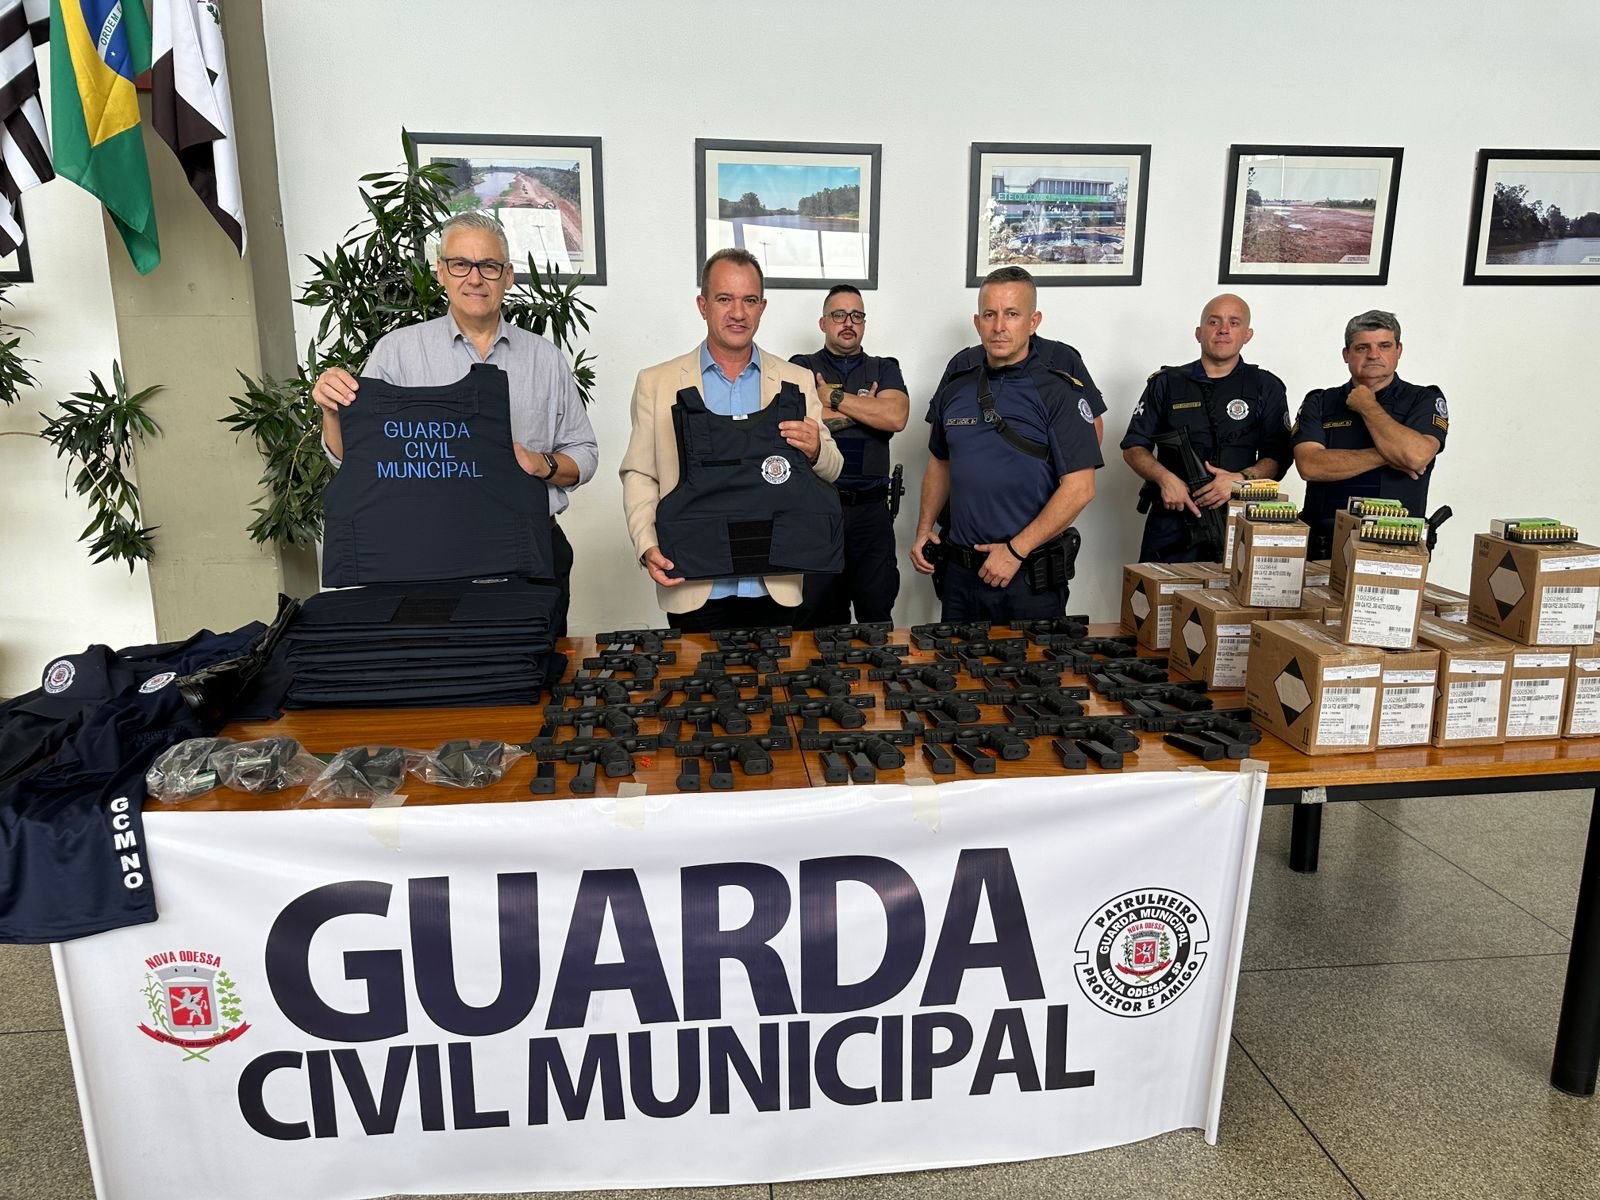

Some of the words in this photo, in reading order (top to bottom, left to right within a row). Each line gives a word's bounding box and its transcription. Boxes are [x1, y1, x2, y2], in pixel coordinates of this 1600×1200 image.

[100, 12, 119, 46] ORDEM
[383, 420, 470, 439] GUARDA
[404, 441, 456, 459] CIVIL
[377, 461, 483, 478] MUNICIPAL
[1095, 893, 1198, 929] PATRULHEIRO
[1127, 923, 1143, 934] NOVA
[1144, 921, 1165, 931] ODESSA
[265, 848, 1045, 1042] GUARDA
[1099, 913, 1138, 955] GUARDA
[1140, 908, 1189, 948] MUNICIPAL
[145, 950, 178, 970] NOVA
[179, 950, 222, 968] ODESSA
[1083, 966, 1142, 1012] PROTETOR
[1147, 998, 1156, 1010] E
[1160, 960, 1199, 1005] AMIGO
[1101, 968, 1126, 994] NOVA
[1127, 981, 1168, 998] ODESSA
[1172, 961, 1183, 977] SP
[238, 1042, 509, 1140] CIVIL
[528, 1004, 1095, 1125] MUNICIPAL
